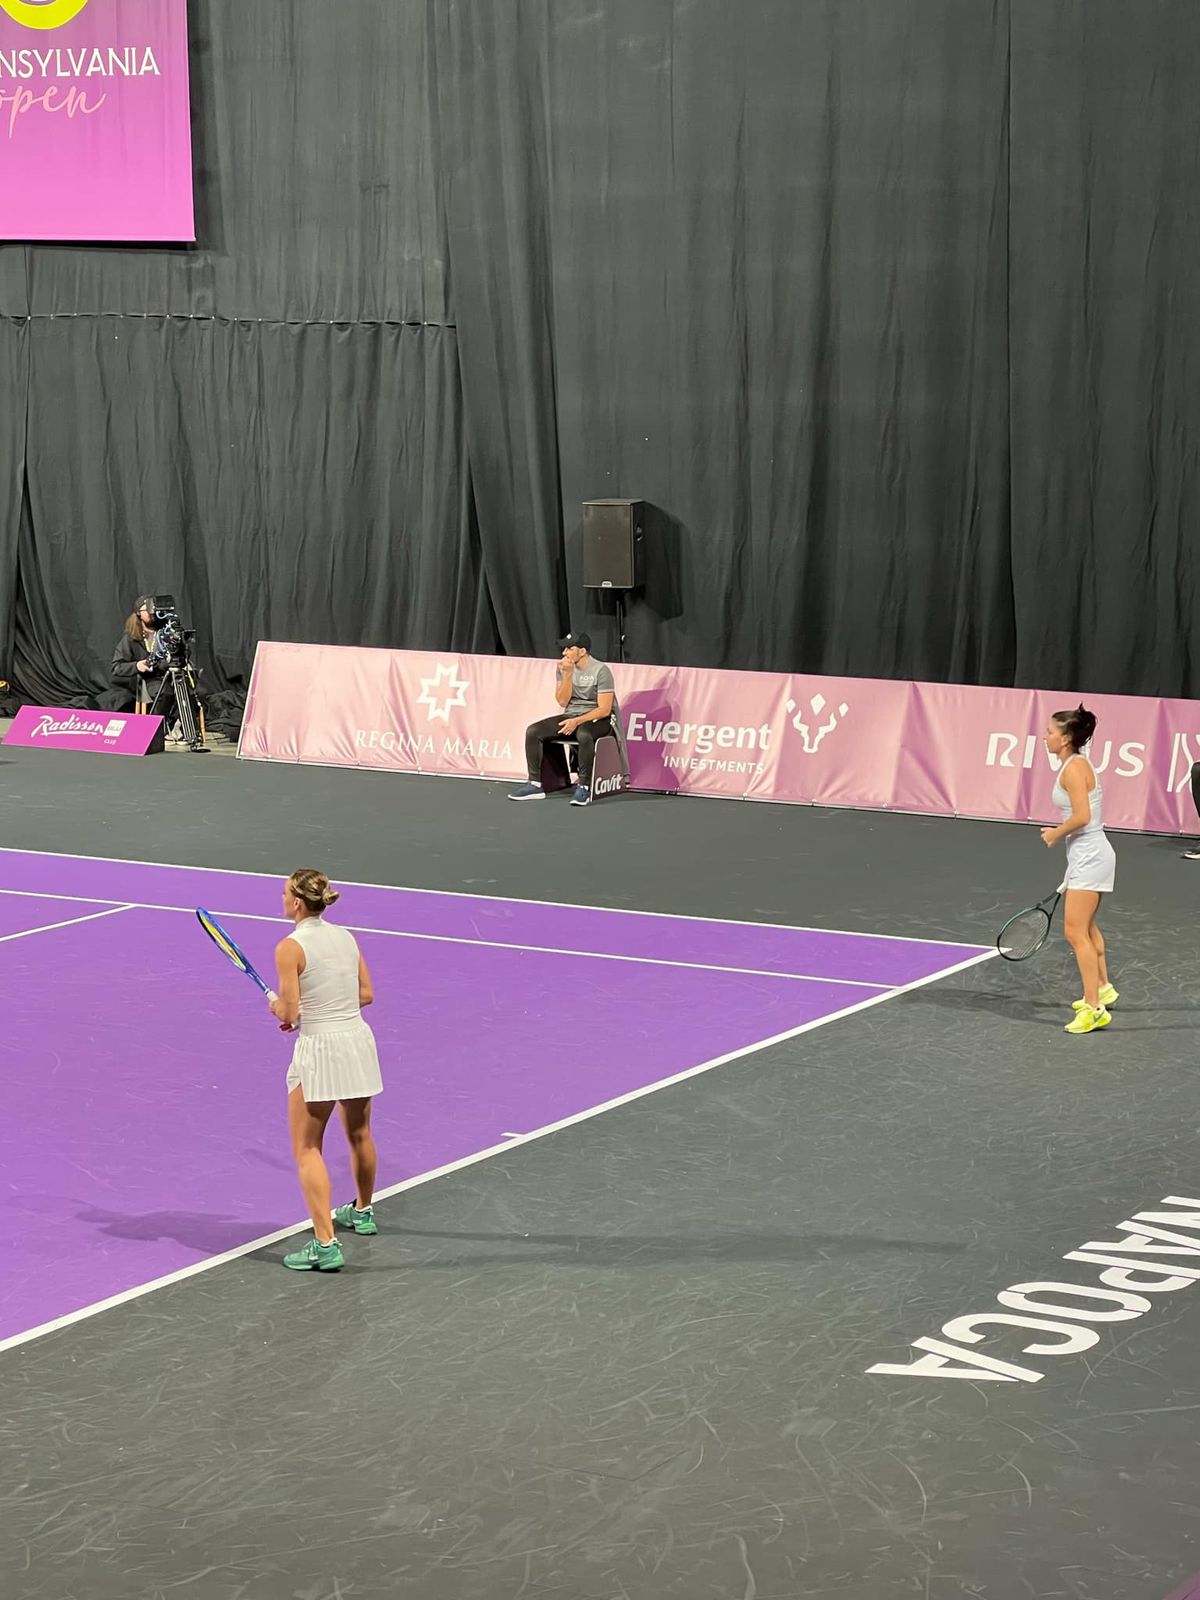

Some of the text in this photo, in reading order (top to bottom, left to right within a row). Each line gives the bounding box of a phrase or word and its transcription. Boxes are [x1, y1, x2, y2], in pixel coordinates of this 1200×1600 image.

[31, 714, 104, 738] Radisson
[626, 712, 772, 754] Evergent
[354, 729, 513, 759] REGINA MARIA
[663, 755, 765, 775] INVESTMENTS
